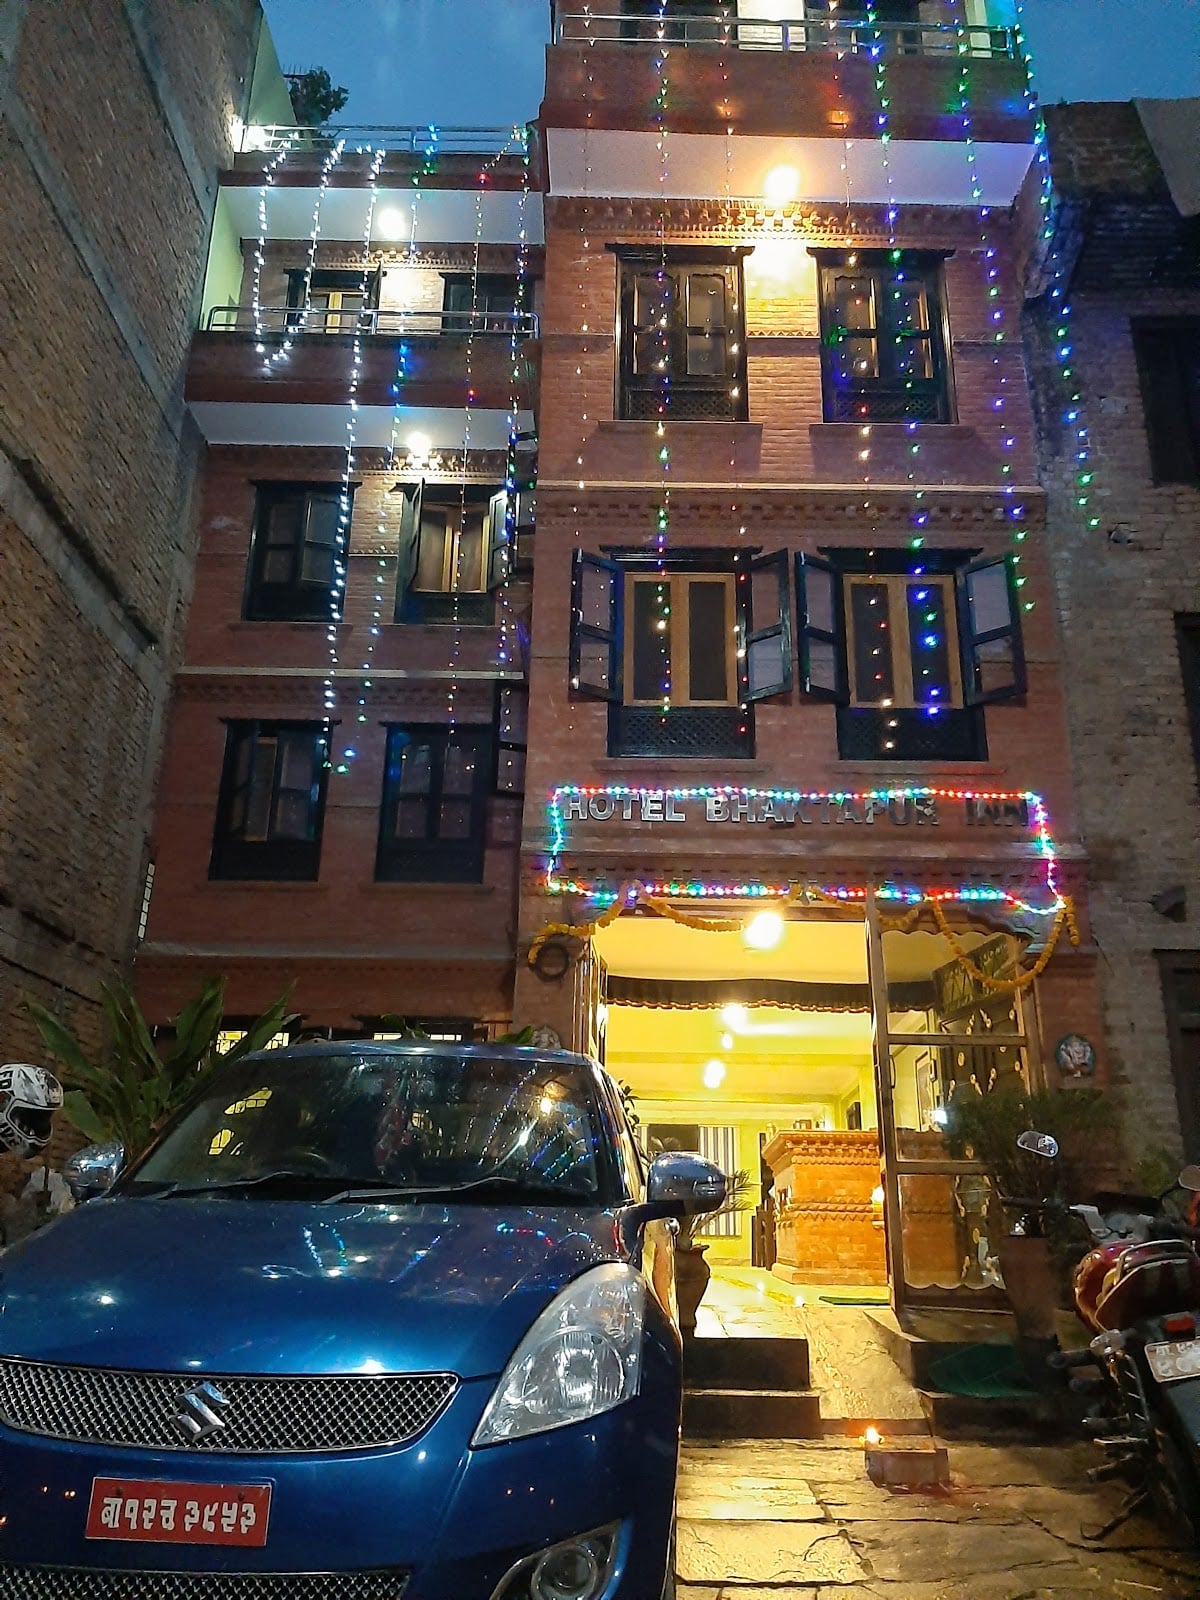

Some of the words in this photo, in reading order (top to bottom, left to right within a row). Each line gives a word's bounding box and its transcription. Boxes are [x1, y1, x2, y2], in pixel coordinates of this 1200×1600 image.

[563, 792, 686, 822] HOTEL
[706, 794, 940, 825] BHAKTAPUR
[965, 797, 1029, 826] INN
